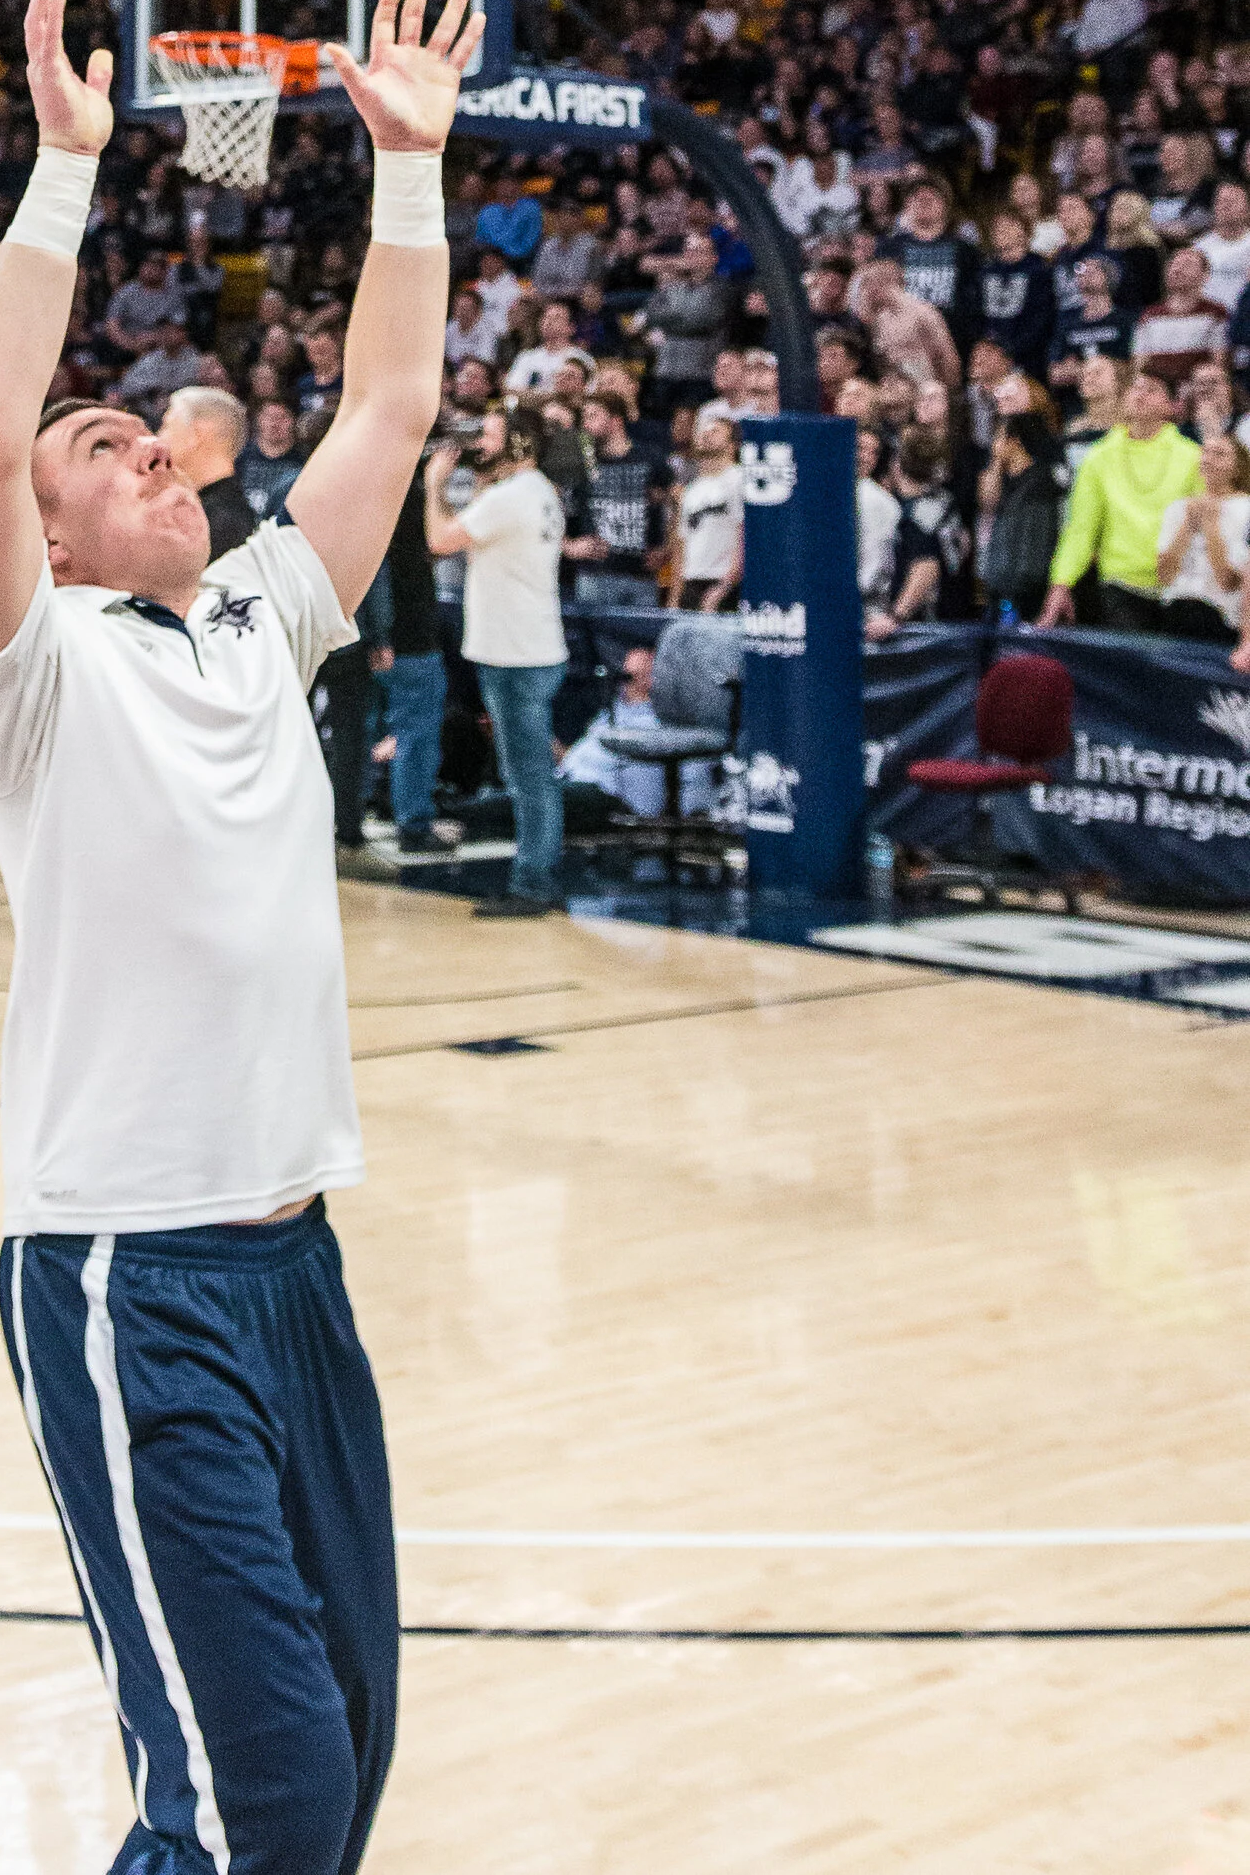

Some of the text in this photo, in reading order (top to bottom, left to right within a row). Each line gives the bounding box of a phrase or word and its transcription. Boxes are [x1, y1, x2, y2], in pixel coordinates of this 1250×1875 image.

[455, 76, 646, 129] ERICA FIRST
[1028, 781, 1138, 825] Logan
